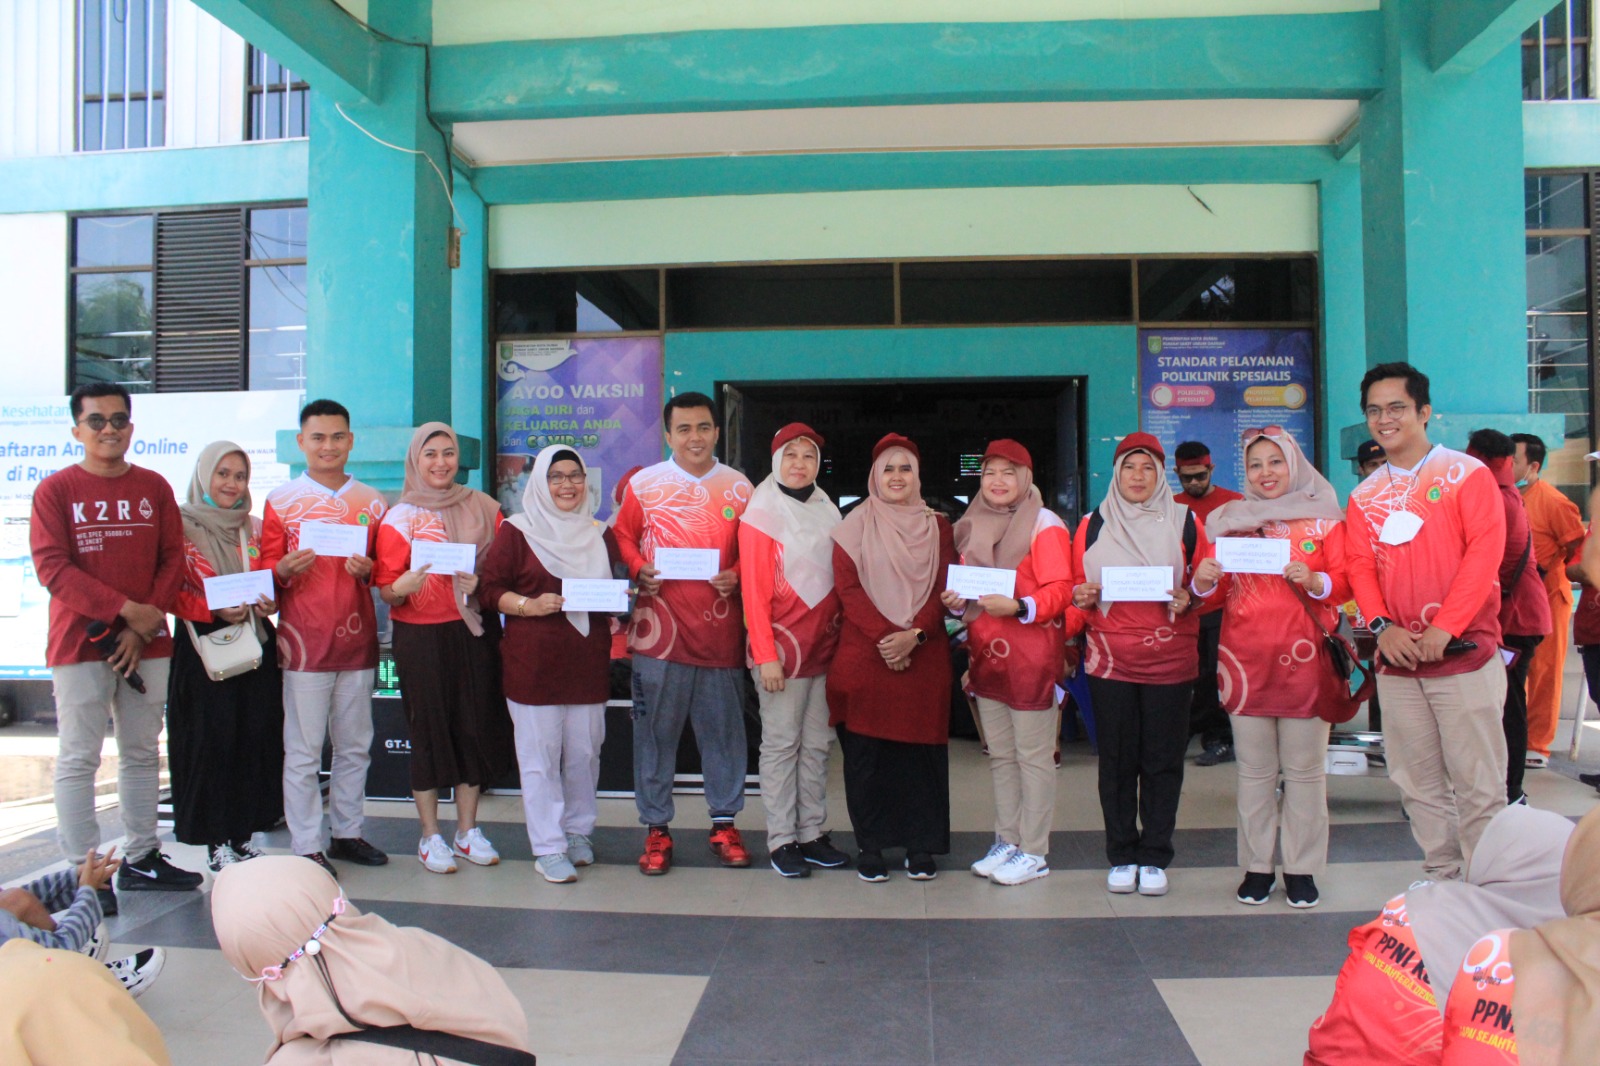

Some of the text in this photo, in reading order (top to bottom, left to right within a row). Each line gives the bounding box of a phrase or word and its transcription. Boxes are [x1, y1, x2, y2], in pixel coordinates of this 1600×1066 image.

[1157, 356, 1294, 367] STANDAR PELAYANAN
[1161, 371, 1291, 382] POLIKLINIK SPESIALIS
[512, 383, 645, 400] AYOO VAKSIN
[504, 404, 595, 416] JAGA DIRI dan
[503, 419, 622, 431] KELUARGA ANDA
[0, 441, 57, 457] aftaran
[133, 437, 189, 455] Online
[526, 434, 599, 449] COVID-19
[7, 464, 22, 481] di
[1374, 931, 1416, 968] PPNI
